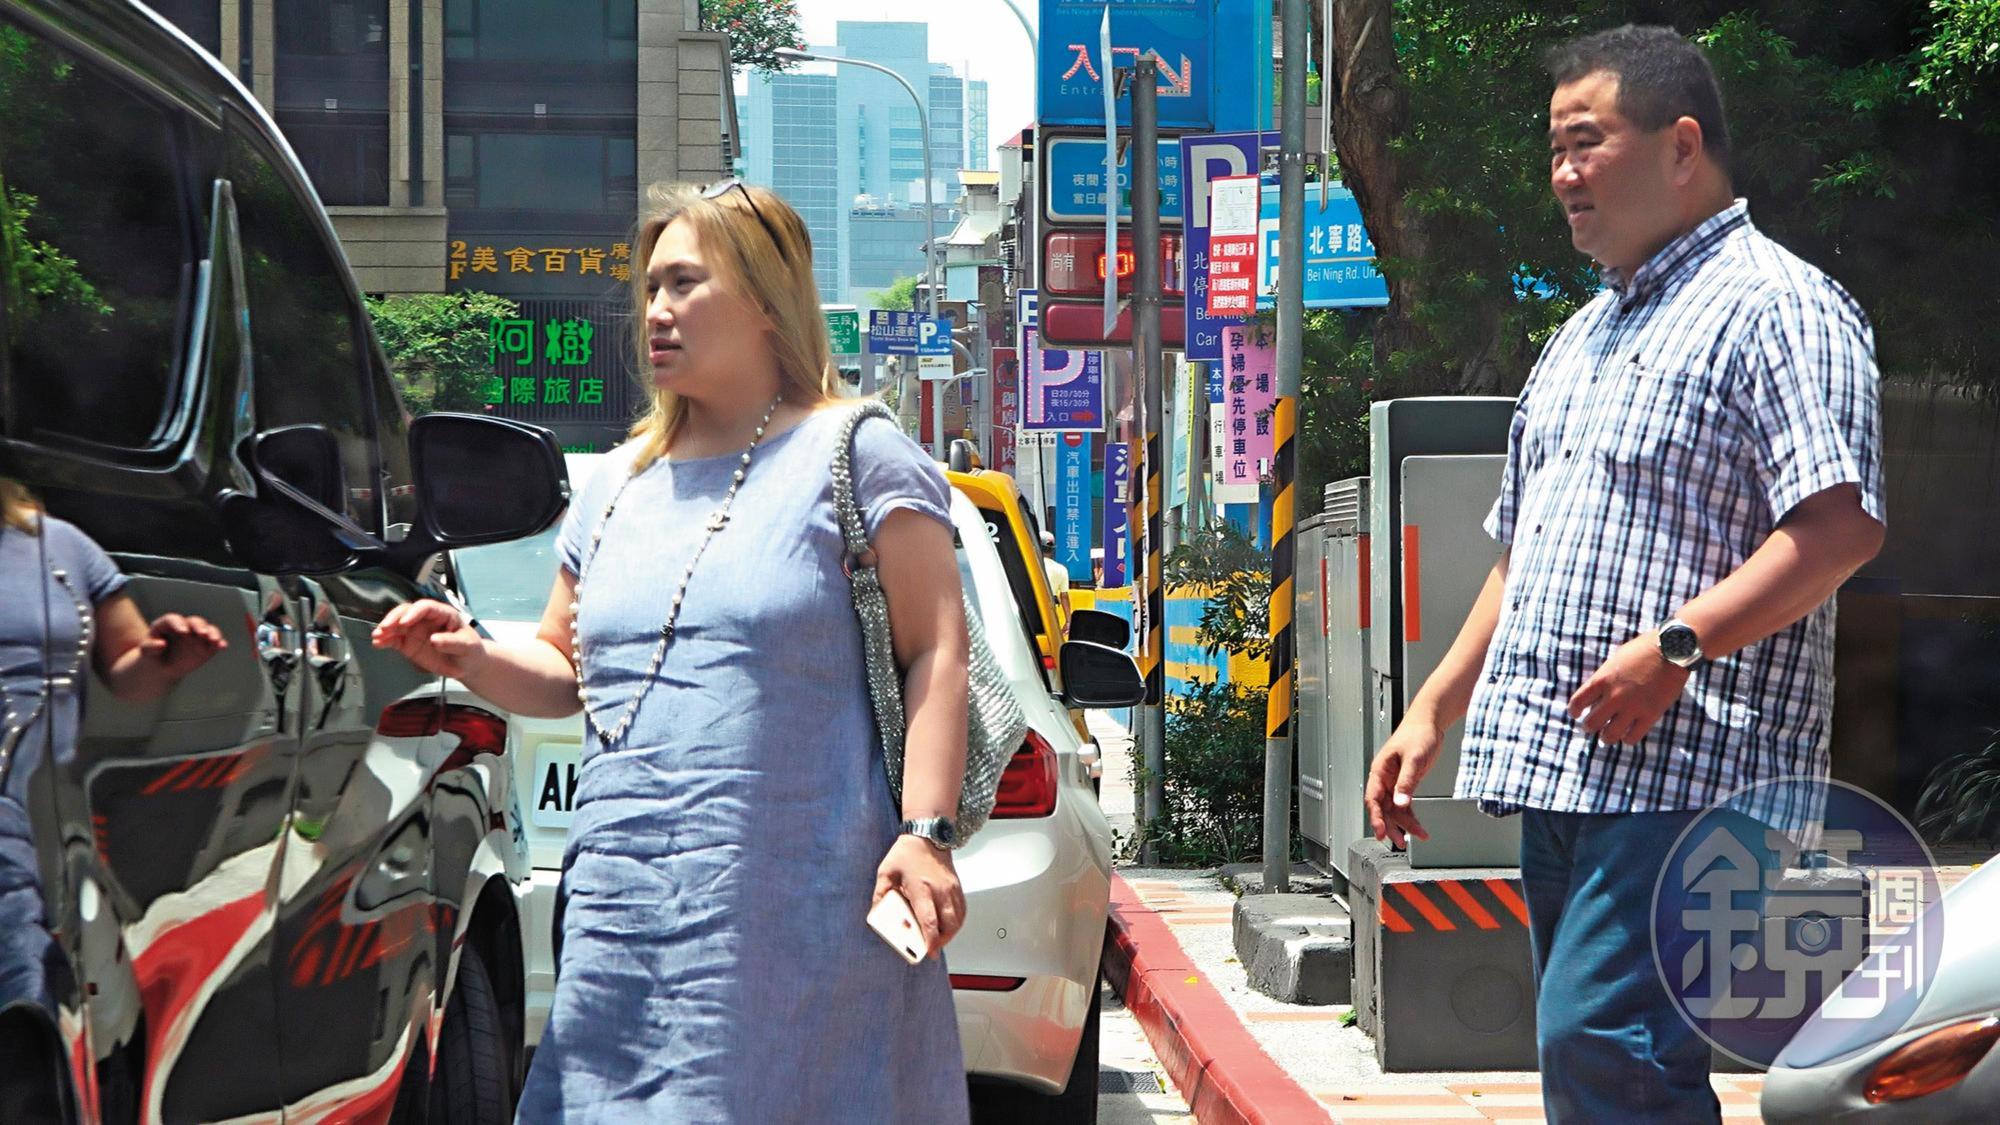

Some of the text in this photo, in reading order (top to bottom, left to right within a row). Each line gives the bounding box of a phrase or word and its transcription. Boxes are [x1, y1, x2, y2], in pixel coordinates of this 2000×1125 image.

[1073, 173, 1099, 187] 夜間
[1309, 224, 1376, 255] 北寧路
[471, 246, 606, 275] 美食百貨
[1307, 268, 1321, 282] Bei
[1323, 267, 1344, 284] Ning
[1345, 266, 1361, 280] Rd.
[920, 322, 937, 344] P
[1195, 332, 1218, 346] Car
[1065, 451, 1080, 563] 汽車出口禁止進入
